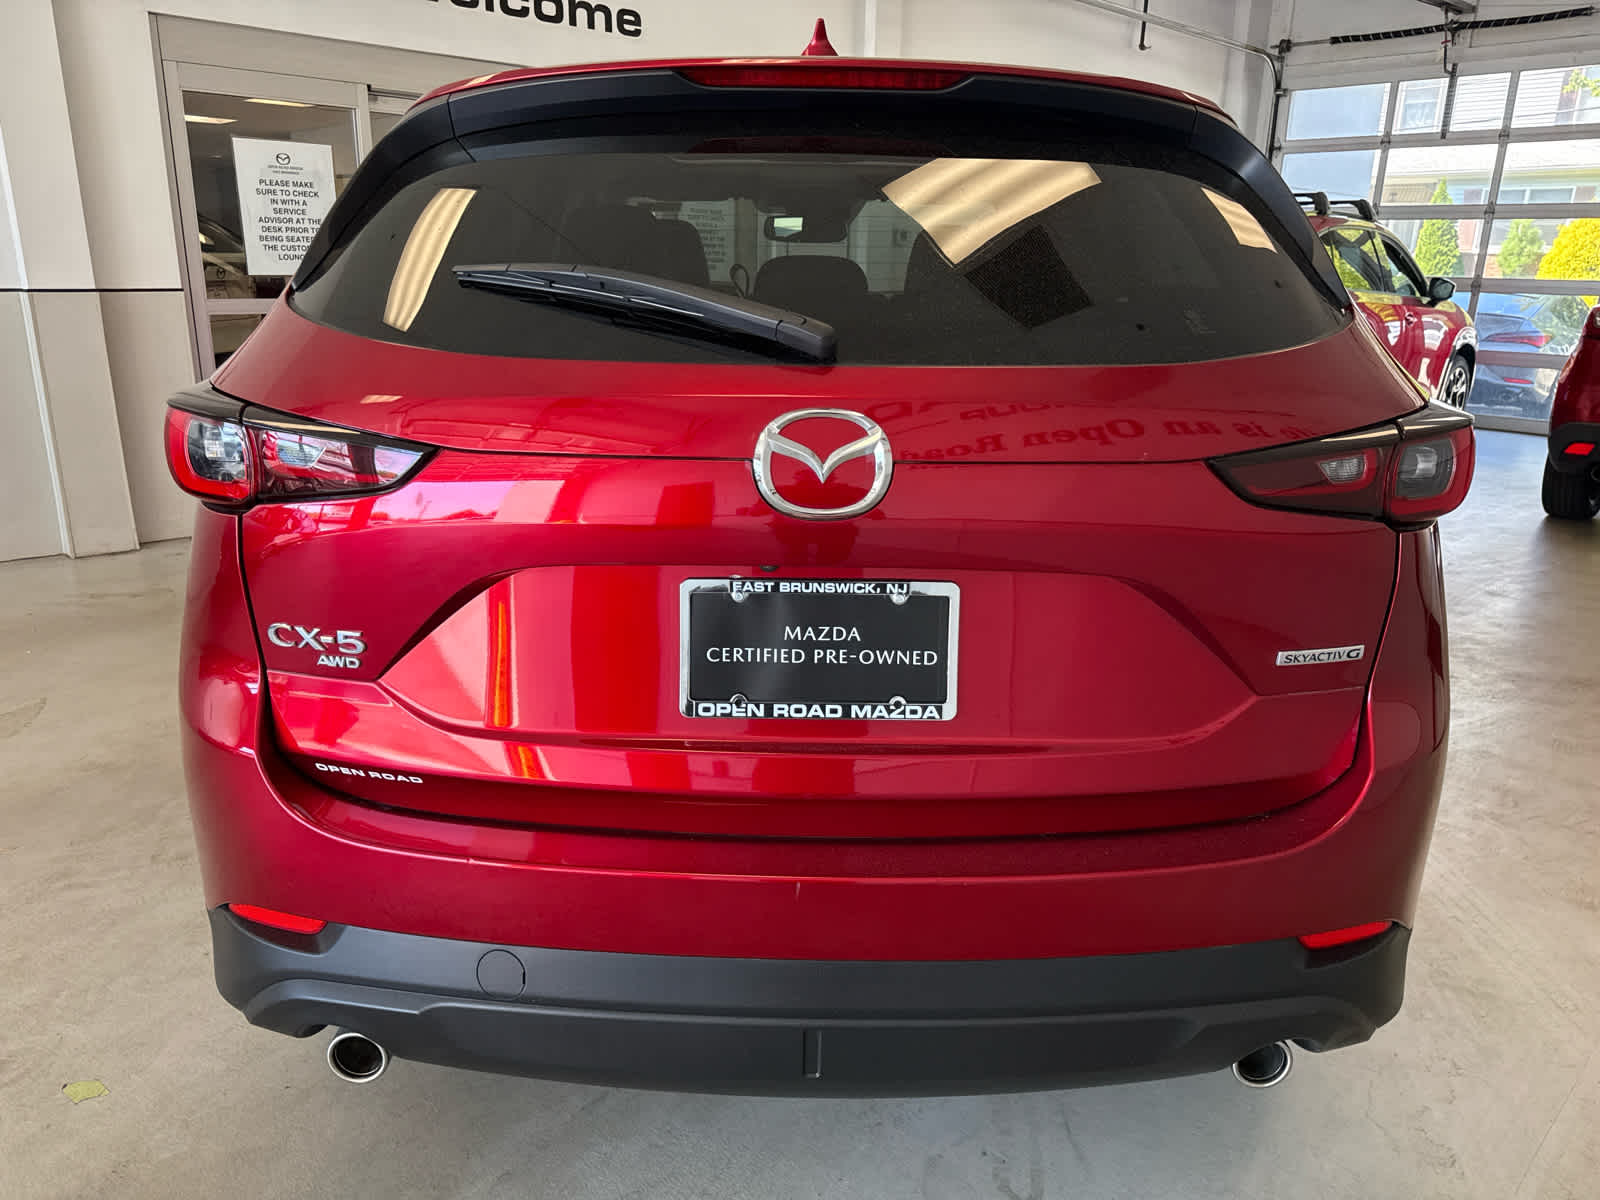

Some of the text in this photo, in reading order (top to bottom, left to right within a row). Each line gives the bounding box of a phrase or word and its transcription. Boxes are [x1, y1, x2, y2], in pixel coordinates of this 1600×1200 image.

[258, 178, 315, 189] PLEASE MAKE
[255, 188, 319, 198] SURE TO CHECK
[270, 198, 279, 206] IN
[281, 199, 300, 207] WITH
[272, 207, 308, 216] SERVICE
[258, 216, 294, 225] ADVISOR
[295, 217, 306, 225] AT
[261, 225, 283, 234] DESK
[285, 226, 309, 234] PRIOR
[259, 235, 284, 243] BEING
[263, 244, 279, 252] THE
[732, 581, 908, 594] EAST BRUNSWICK, NJ
[267, 622, 366, 655] CX-5
[783, 626, 862, 642] MAZDA
[316, 655, 361, 669] AWD
[706, 647, 938, 666] CERTIFIED PRE-OWNED
[698, 702, 765, 718] OPEN
[773, 703, 843, 719] ROAD
[314, 762, 424, 784] OPEN ROAD
